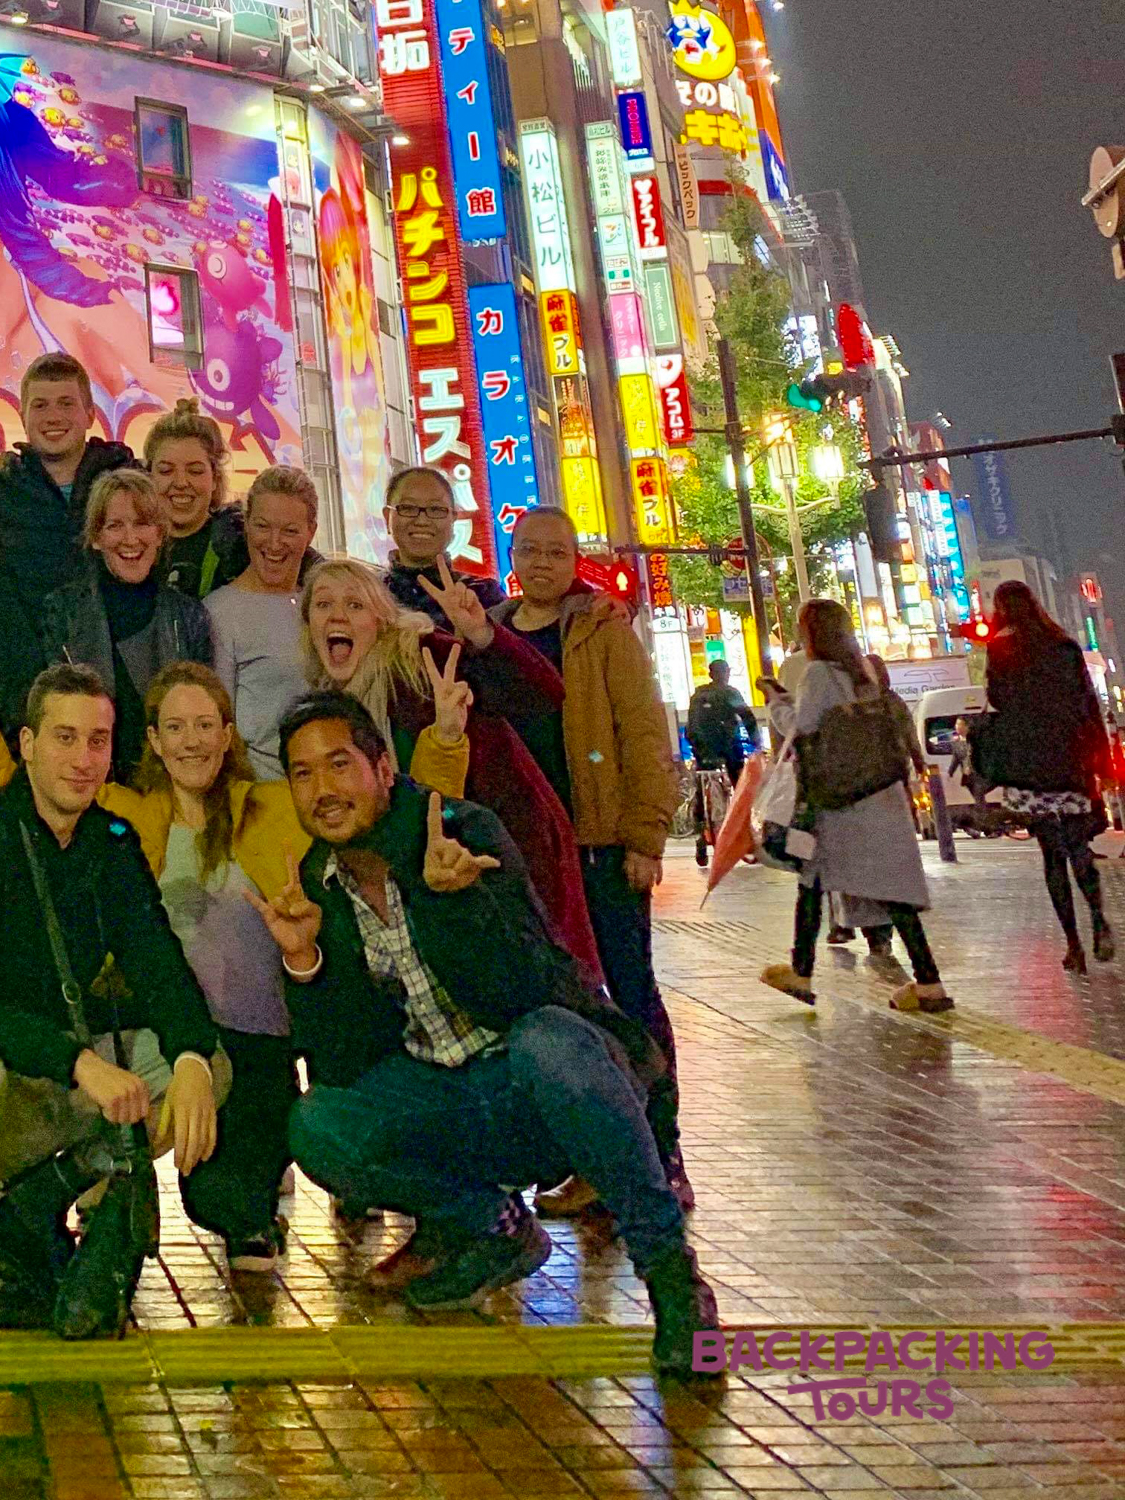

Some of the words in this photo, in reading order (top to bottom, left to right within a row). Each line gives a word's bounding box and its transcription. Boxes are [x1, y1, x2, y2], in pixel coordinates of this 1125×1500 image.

[527, 147, 563, 268] 小松ビル
[637, 192, 661, 248] アイフル
[395, 165, 457, 348] パチンコ
[664, 387, 685, 429] アコム
[659, 618, 674, 629] 8F
